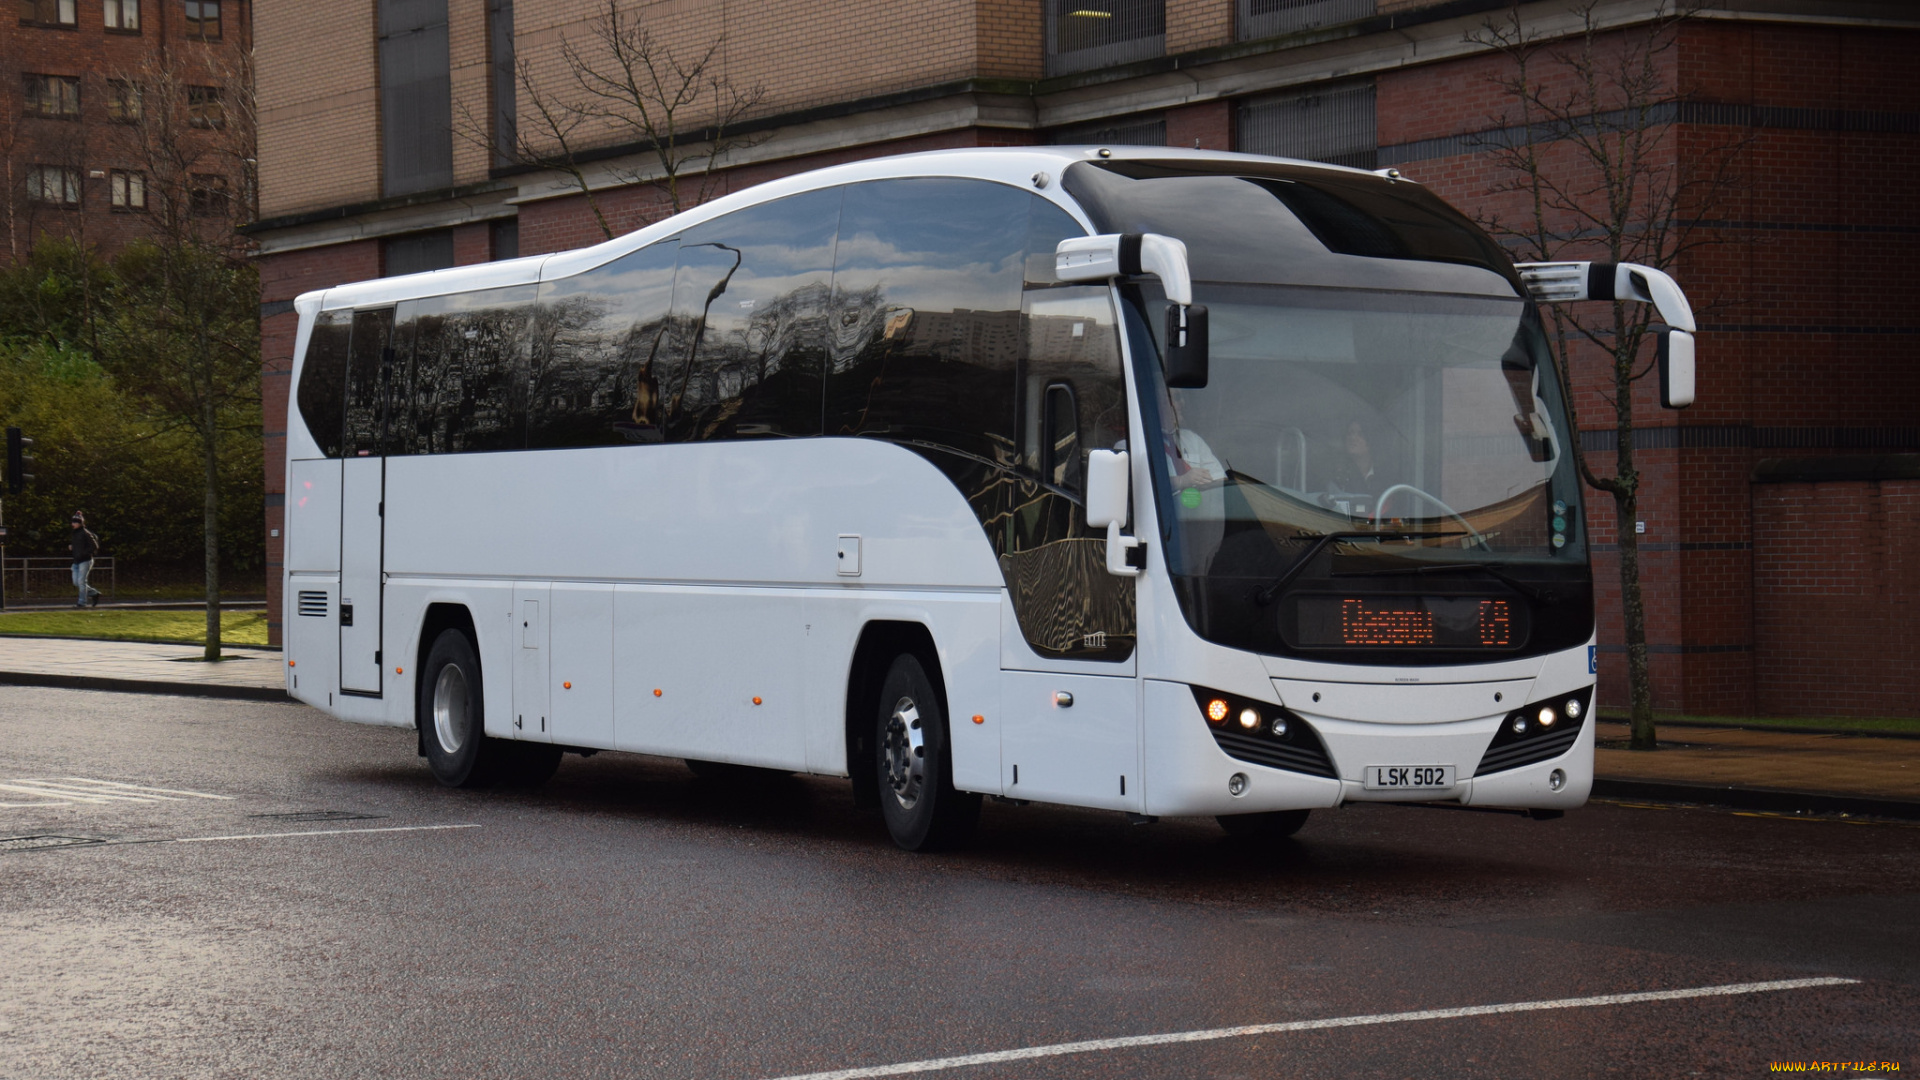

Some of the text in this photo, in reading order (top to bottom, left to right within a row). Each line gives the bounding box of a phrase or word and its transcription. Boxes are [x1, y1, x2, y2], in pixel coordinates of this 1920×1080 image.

[1083, 631, 1106, 648] ELITE
[1378, 768, 1444, 786] LSK 502
